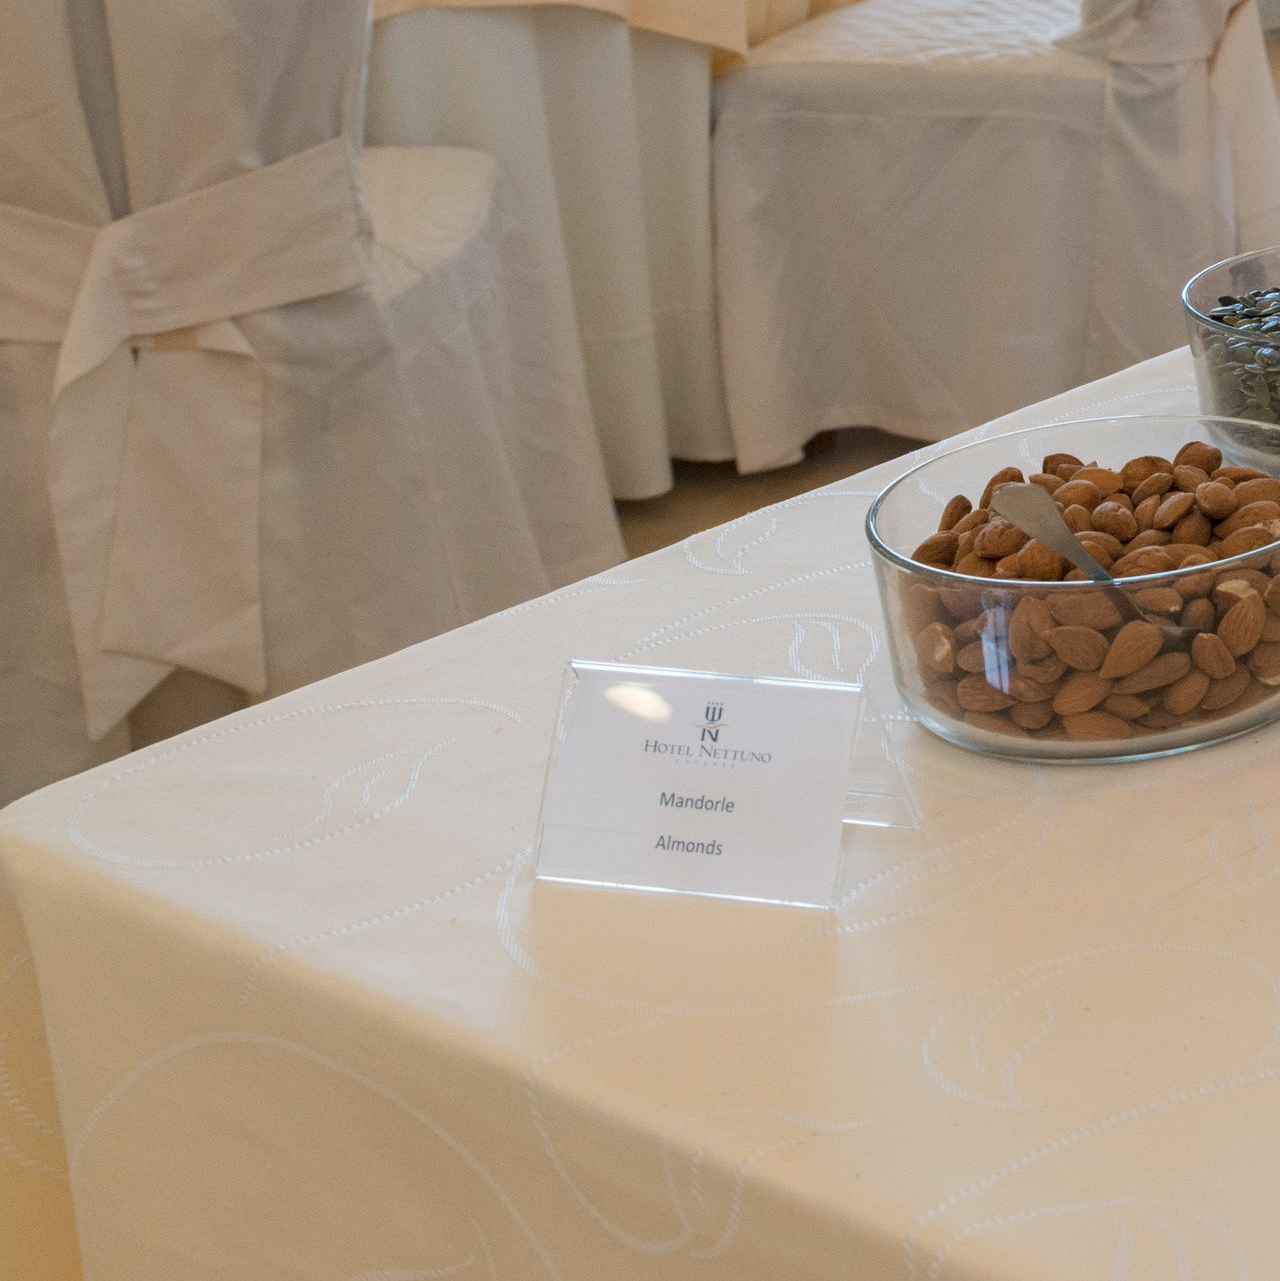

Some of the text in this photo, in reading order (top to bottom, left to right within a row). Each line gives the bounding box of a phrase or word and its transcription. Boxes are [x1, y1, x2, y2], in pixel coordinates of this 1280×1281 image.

[644, 739, 693, 757] HOTEL
[698, 744, 773, 764] NETTUNO
[658, 791, 736, 814] Mandorle
[654, 834, 724, 857] Almonds
